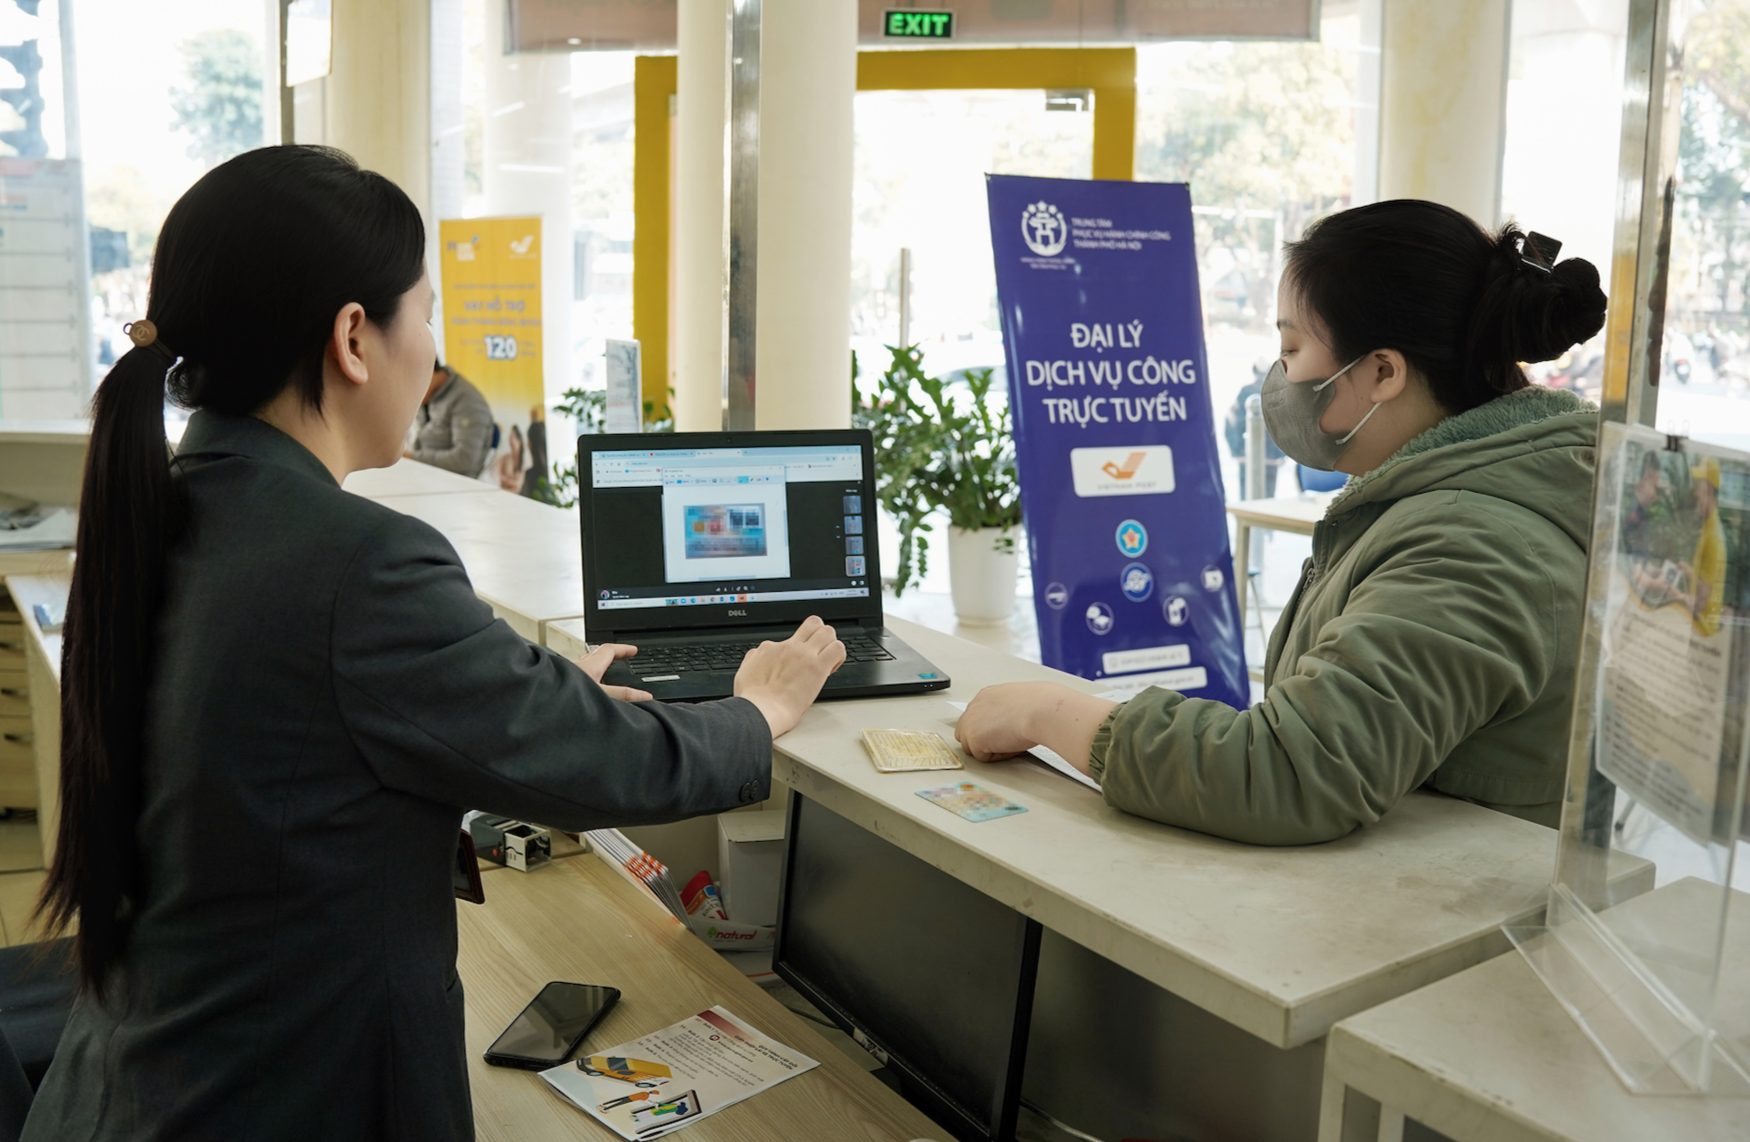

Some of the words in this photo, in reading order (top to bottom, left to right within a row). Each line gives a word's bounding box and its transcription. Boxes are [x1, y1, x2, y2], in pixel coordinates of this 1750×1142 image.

[889, 13, 949, 36] EXIT
[1071, 217, 1096, 228] TRUNG
[484, 335, 518, 360] 120
[1070, 322, 1114, 353] ĐẠI
[1118, 319, 1144, 349] LÝ
[1025, 360, 1085, 392] DỊCH
[1089, 360, 1123, 391] VỤ
[1127, 356, 1196, 385] CÔNG
[1042, 395, 1109, 429] TRỰC
[1110, 390, 1187, 423] TUYẾN
[716, 931, 757, 940] natural
